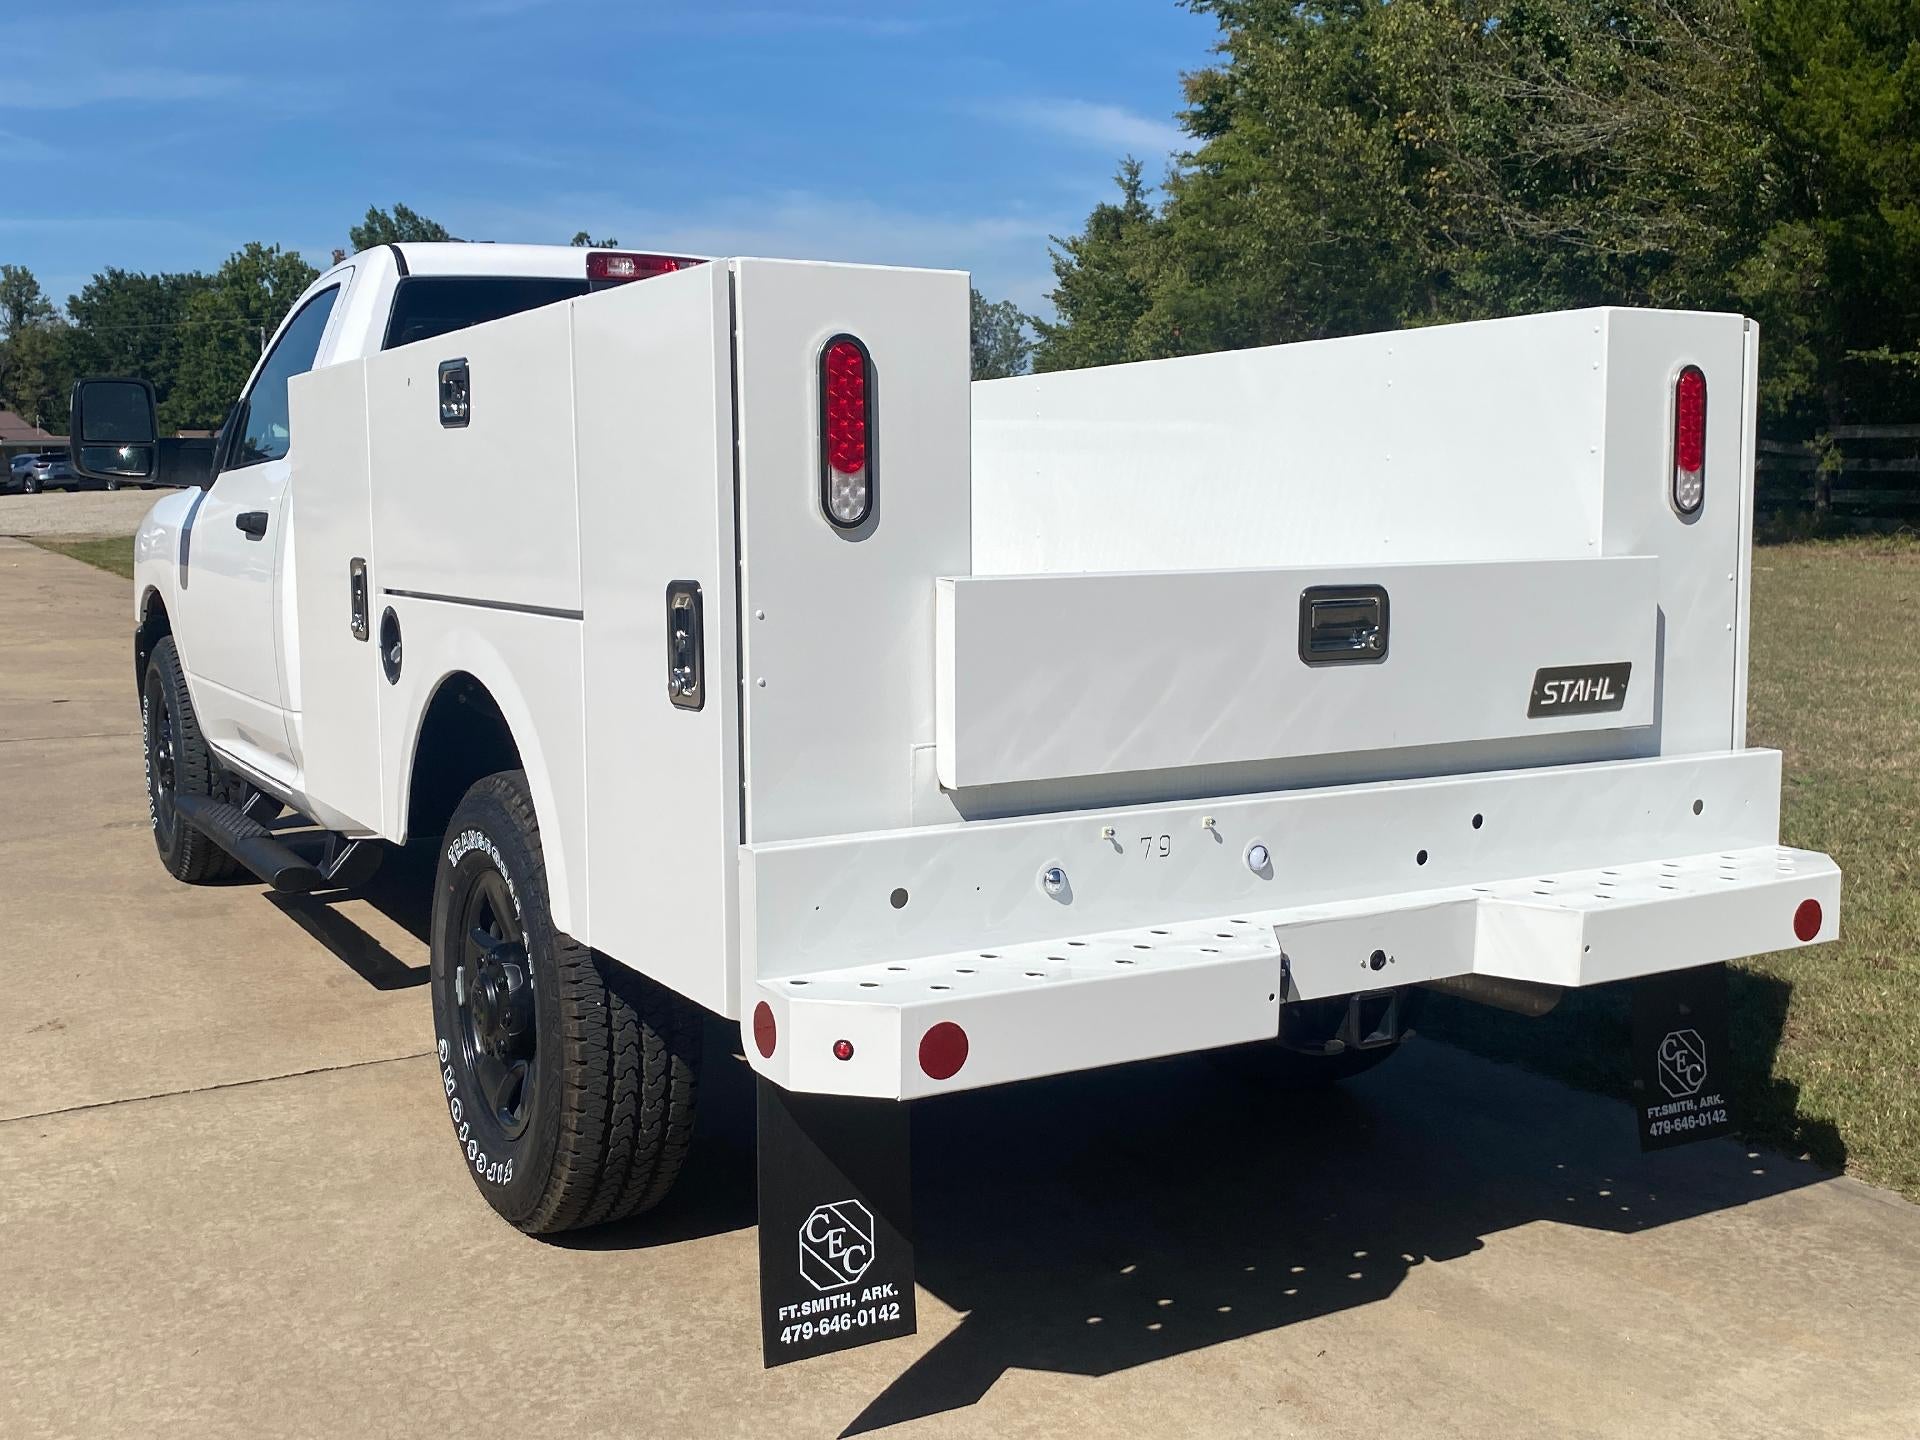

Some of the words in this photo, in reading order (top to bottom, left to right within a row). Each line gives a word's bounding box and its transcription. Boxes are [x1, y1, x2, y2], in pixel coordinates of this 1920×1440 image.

[1540, 677, 1615, 705] STAHL
[1140, 834, 1171, 861] 79
[1661, 1039, 1702, 1086] CEC
[1699, 1094, 1724, 1108] ARK.
[1650, 1109, 1727, 1136] 479-646-0142
[806, 1213, 867, 1274] CEC
[778, 1292, 857, 1321] FT.SMITH,
[861, 1283, 899, 1304] ARK.
[780, 1303, 900, 1345] 479-646-0142
